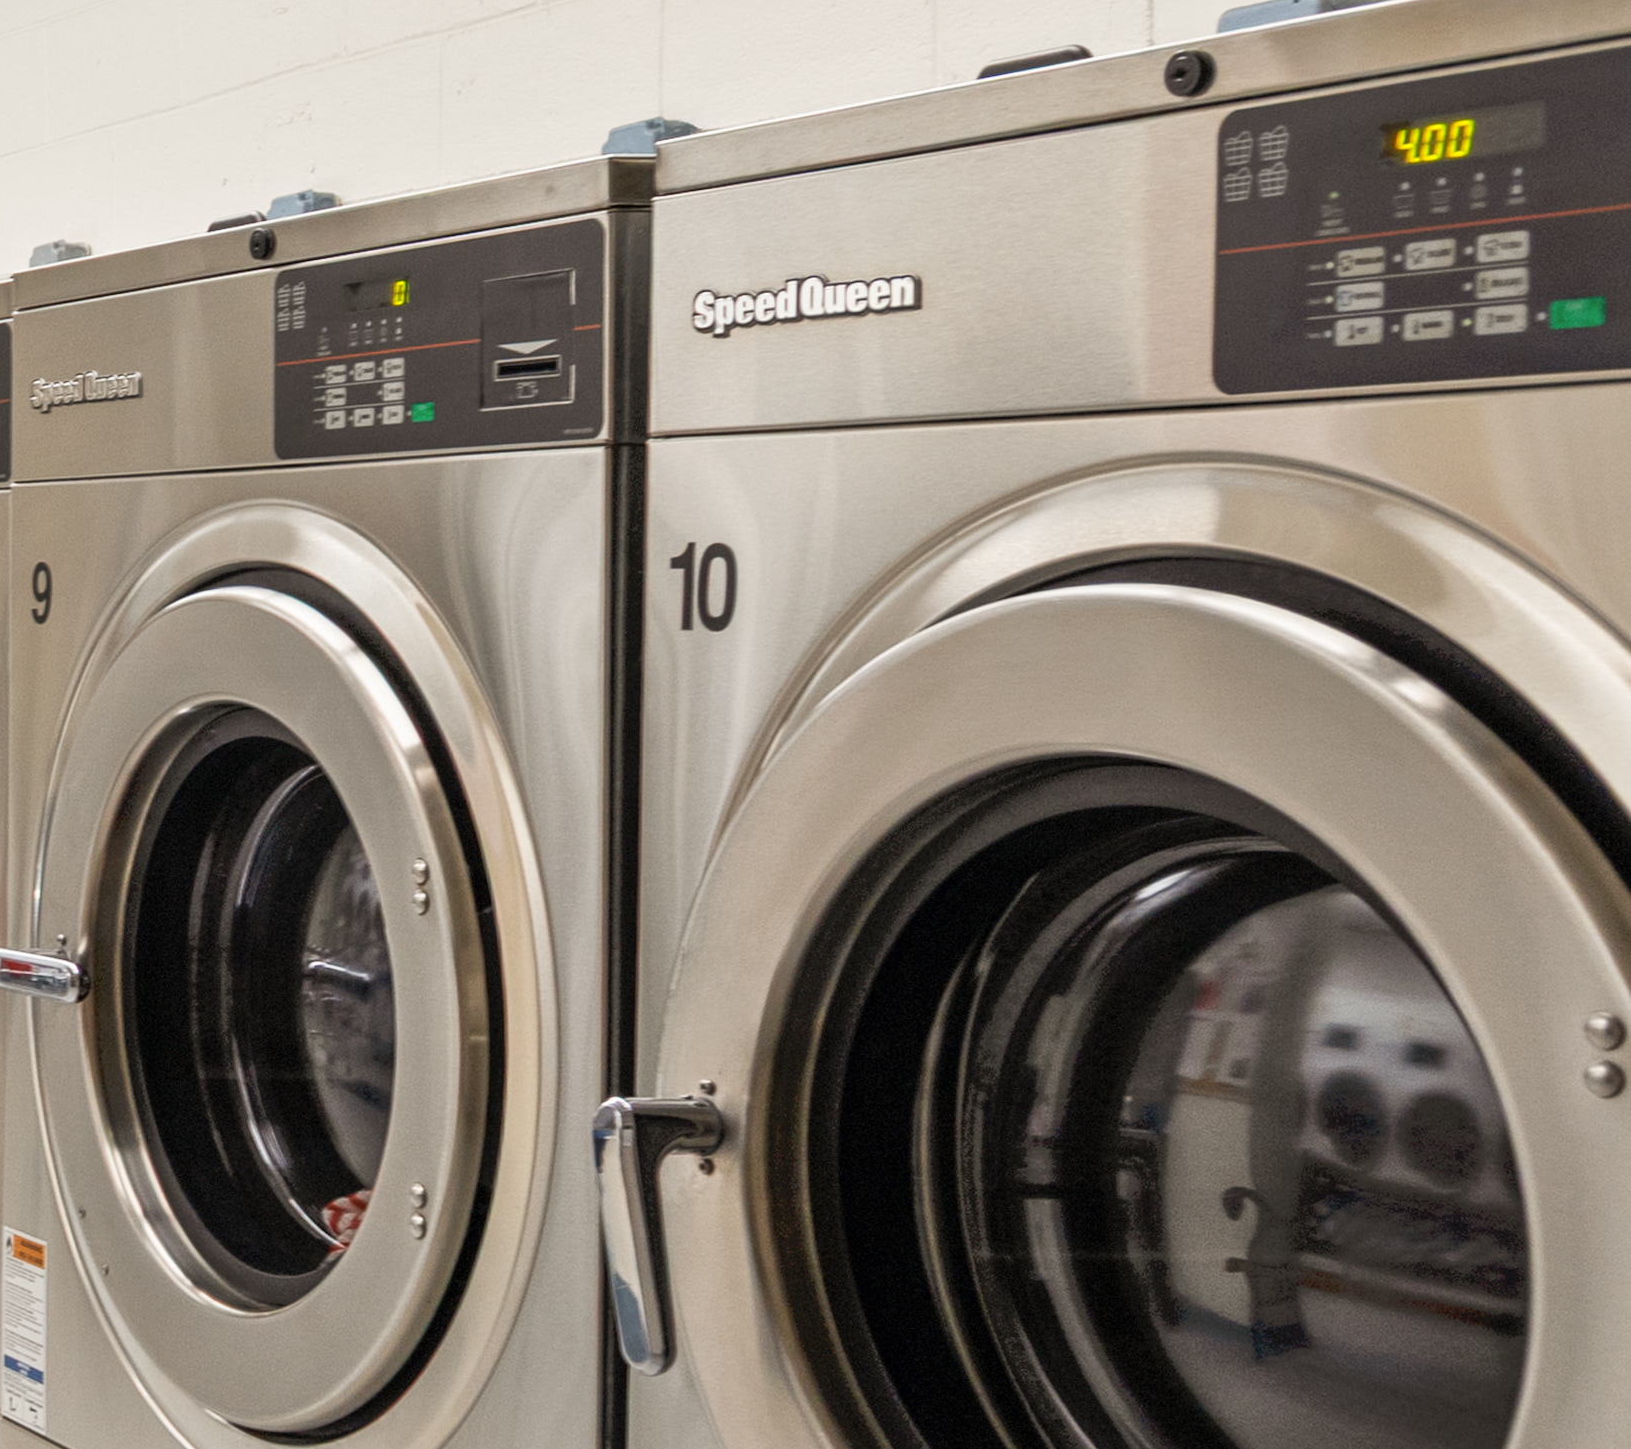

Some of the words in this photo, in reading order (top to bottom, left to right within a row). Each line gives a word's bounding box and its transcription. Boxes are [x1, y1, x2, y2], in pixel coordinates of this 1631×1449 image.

[692, 279, 798, 338] Speed
[798, 273, 922, 318] Queen
[30, 374, 84, 413] Speed
[84, 370, 143, 403] Queen
[31, 562, 52, 625] 9
[669, 542, 738, 632] 10
